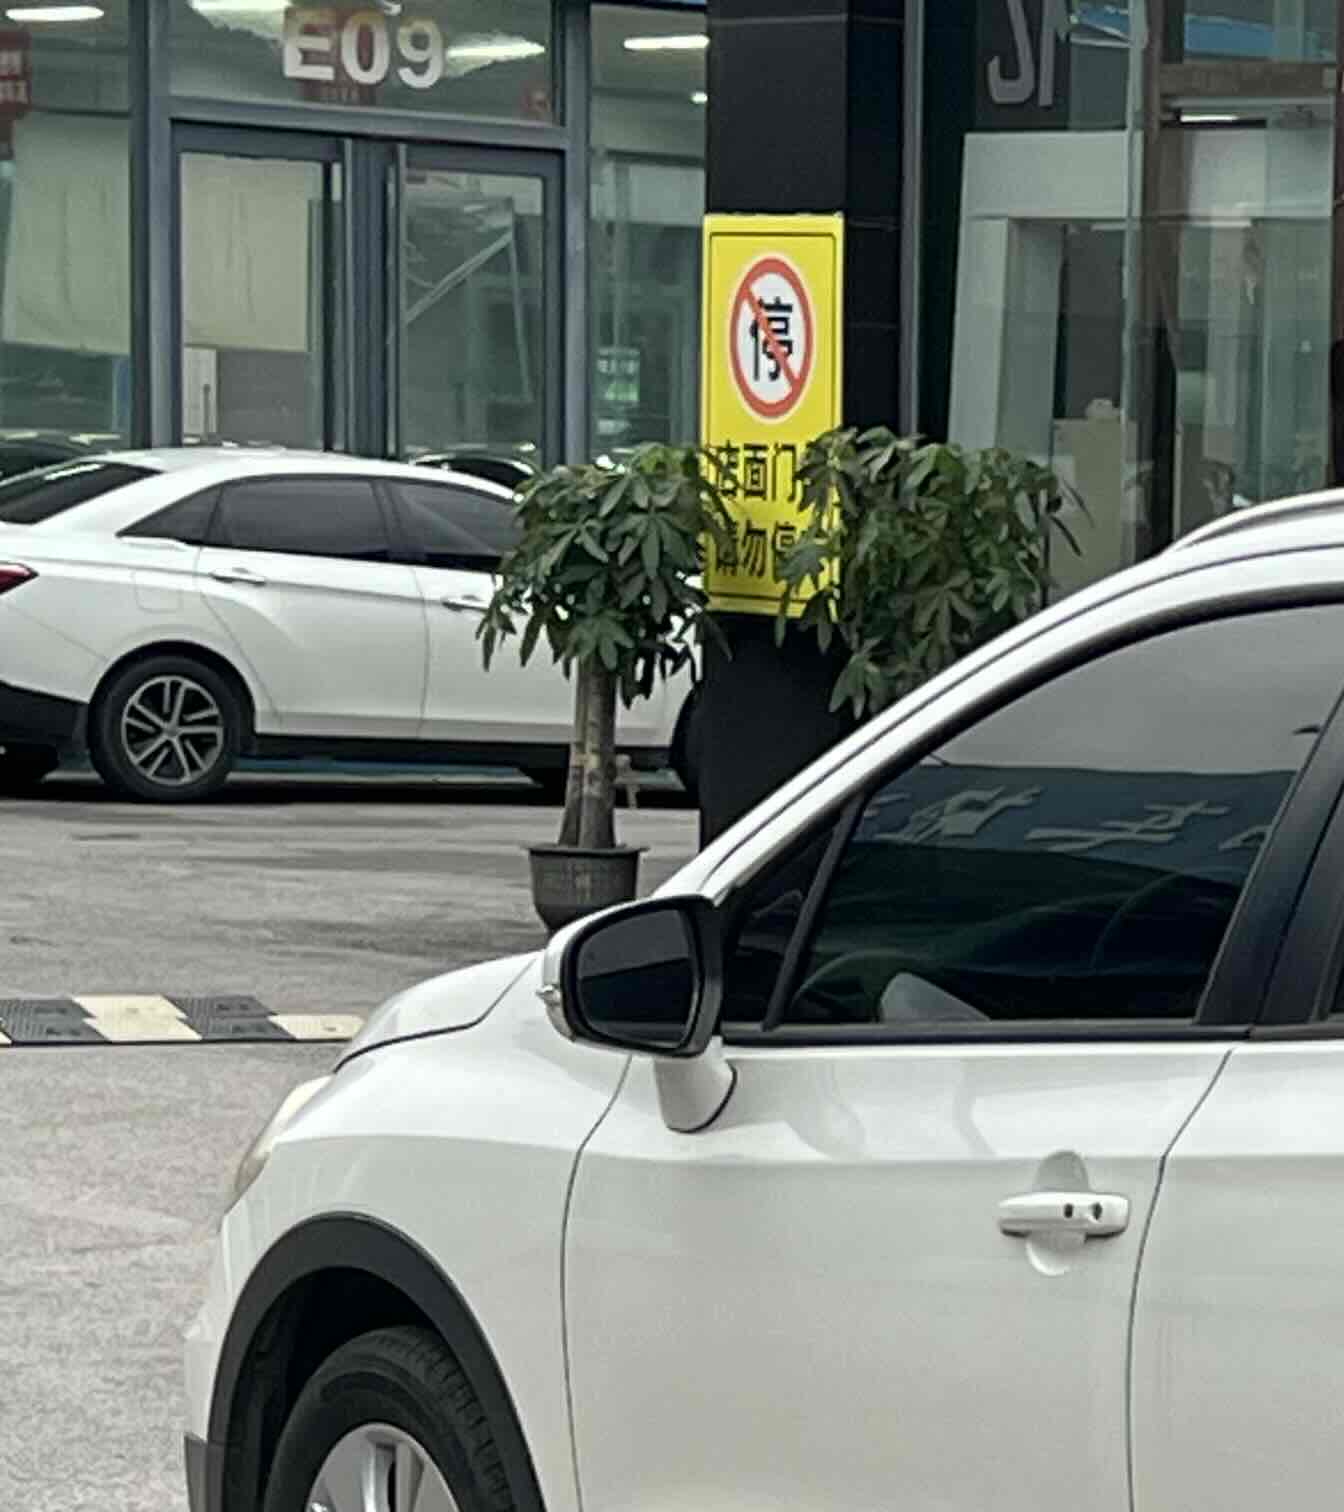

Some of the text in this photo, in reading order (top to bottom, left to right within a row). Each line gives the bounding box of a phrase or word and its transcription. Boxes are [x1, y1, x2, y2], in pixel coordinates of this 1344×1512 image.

[284, 9, 444, 88] E09
[715, 440, 812, 503] 店面门
